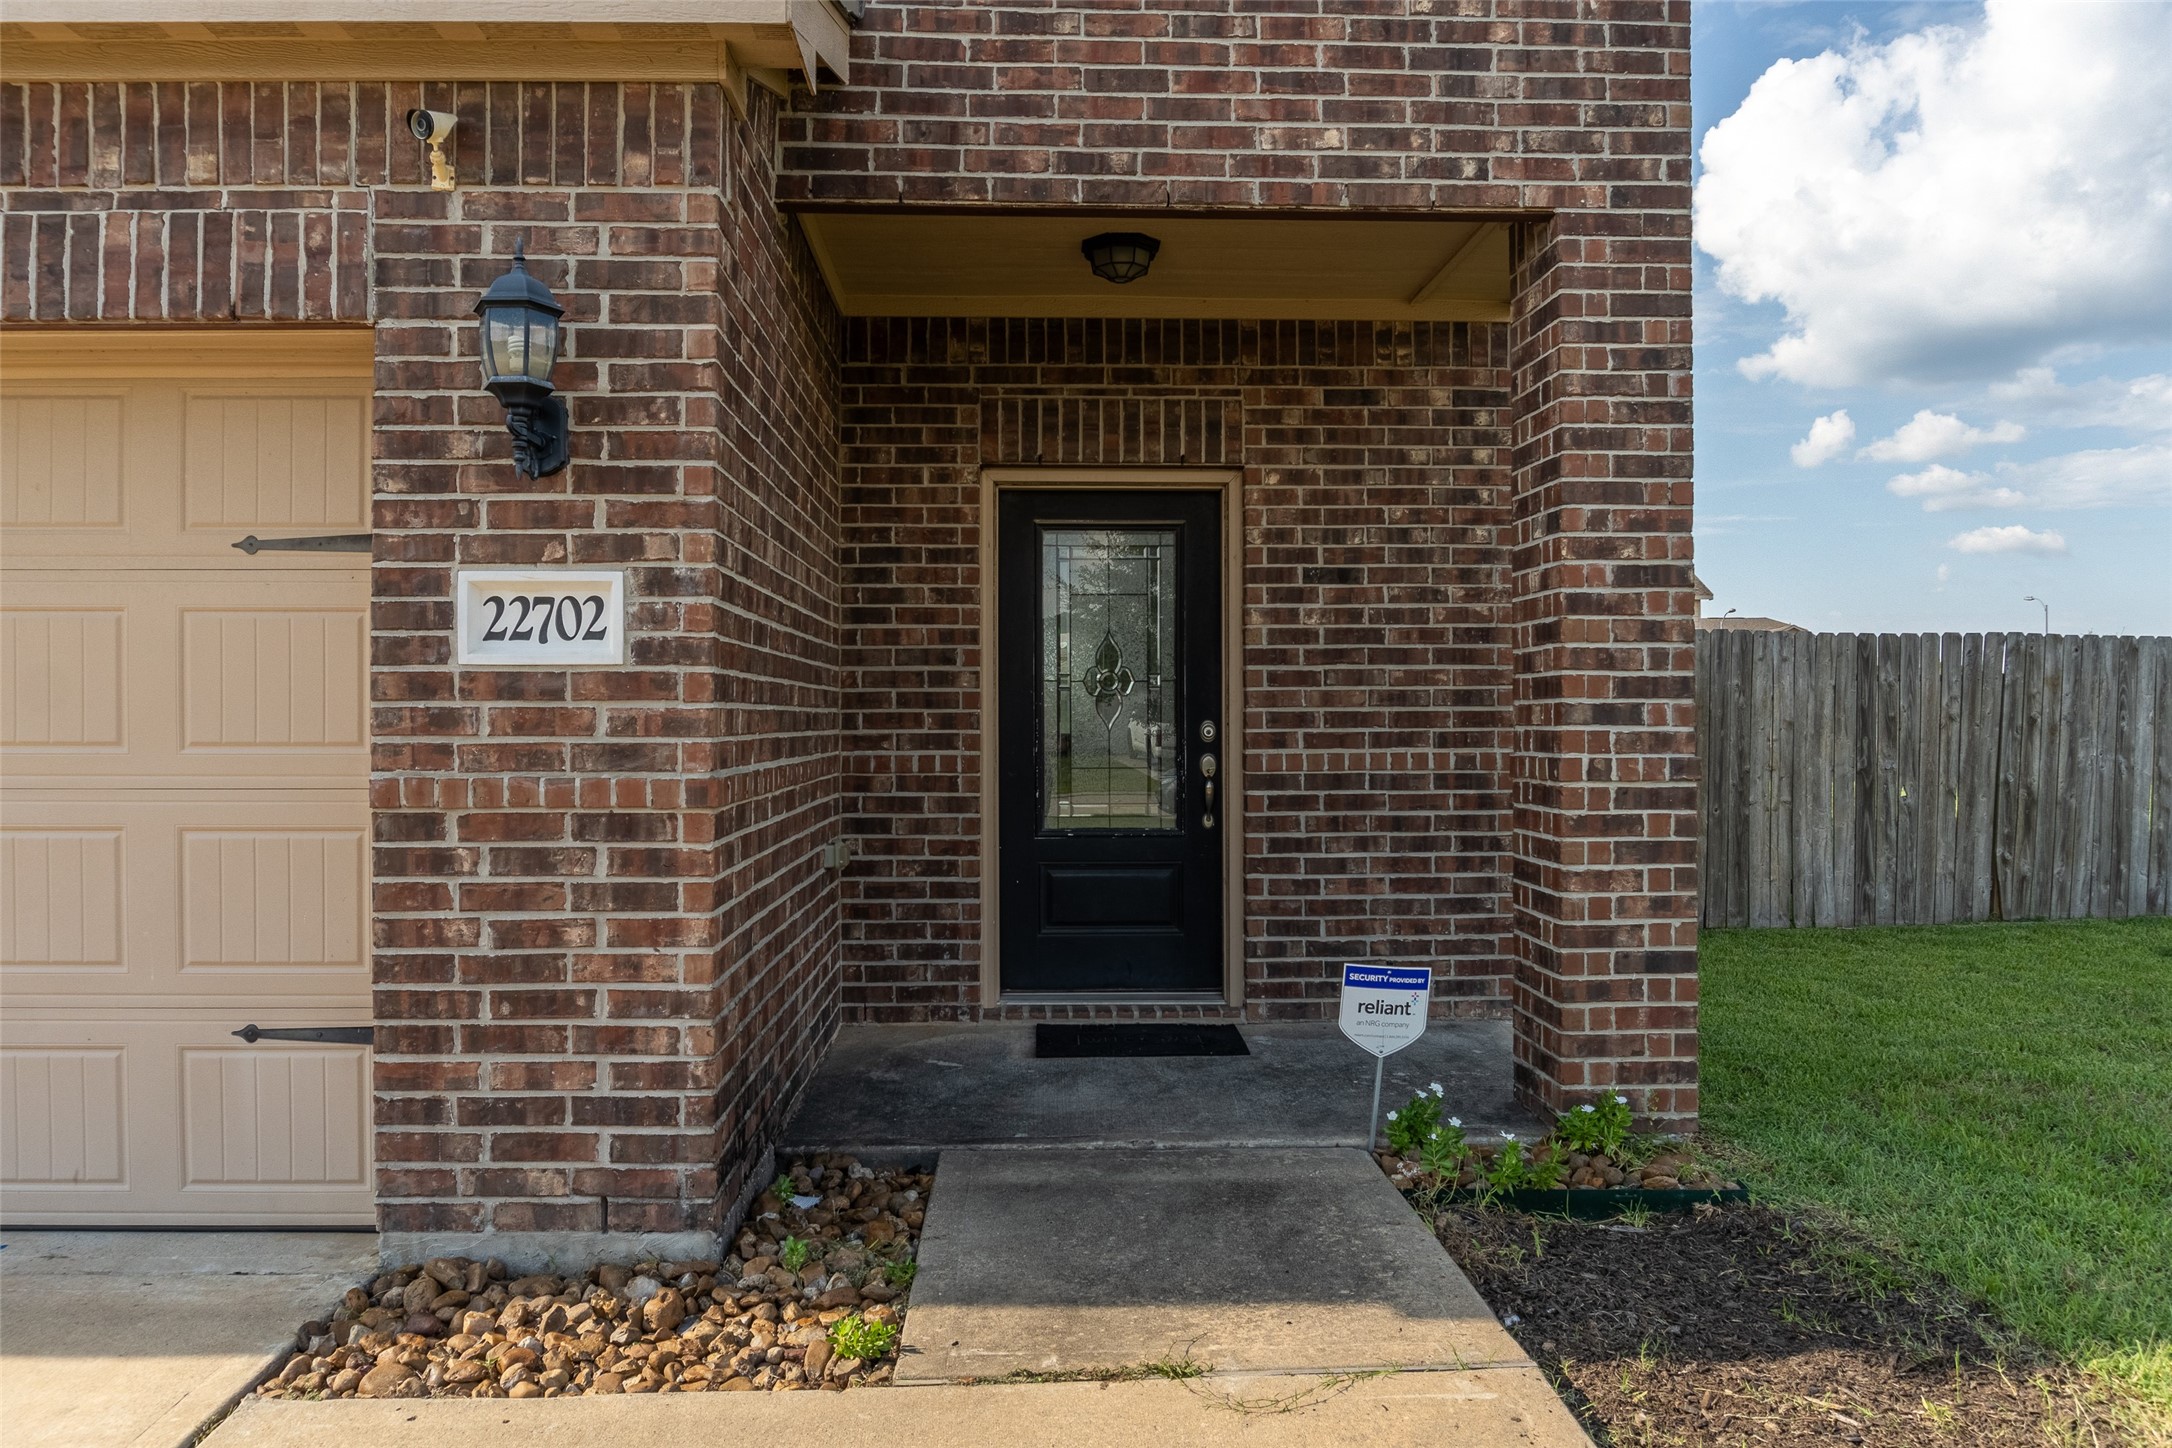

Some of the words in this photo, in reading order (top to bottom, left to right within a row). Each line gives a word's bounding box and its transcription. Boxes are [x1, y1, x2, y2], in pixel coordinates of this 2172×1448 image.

[482, 595, 608, 645] 22702
[1349, 973, 1389, 982] SECURITY
[1357, 999, 1412, 1016] reliant
[1380, 1021, 1410, 1029] company
